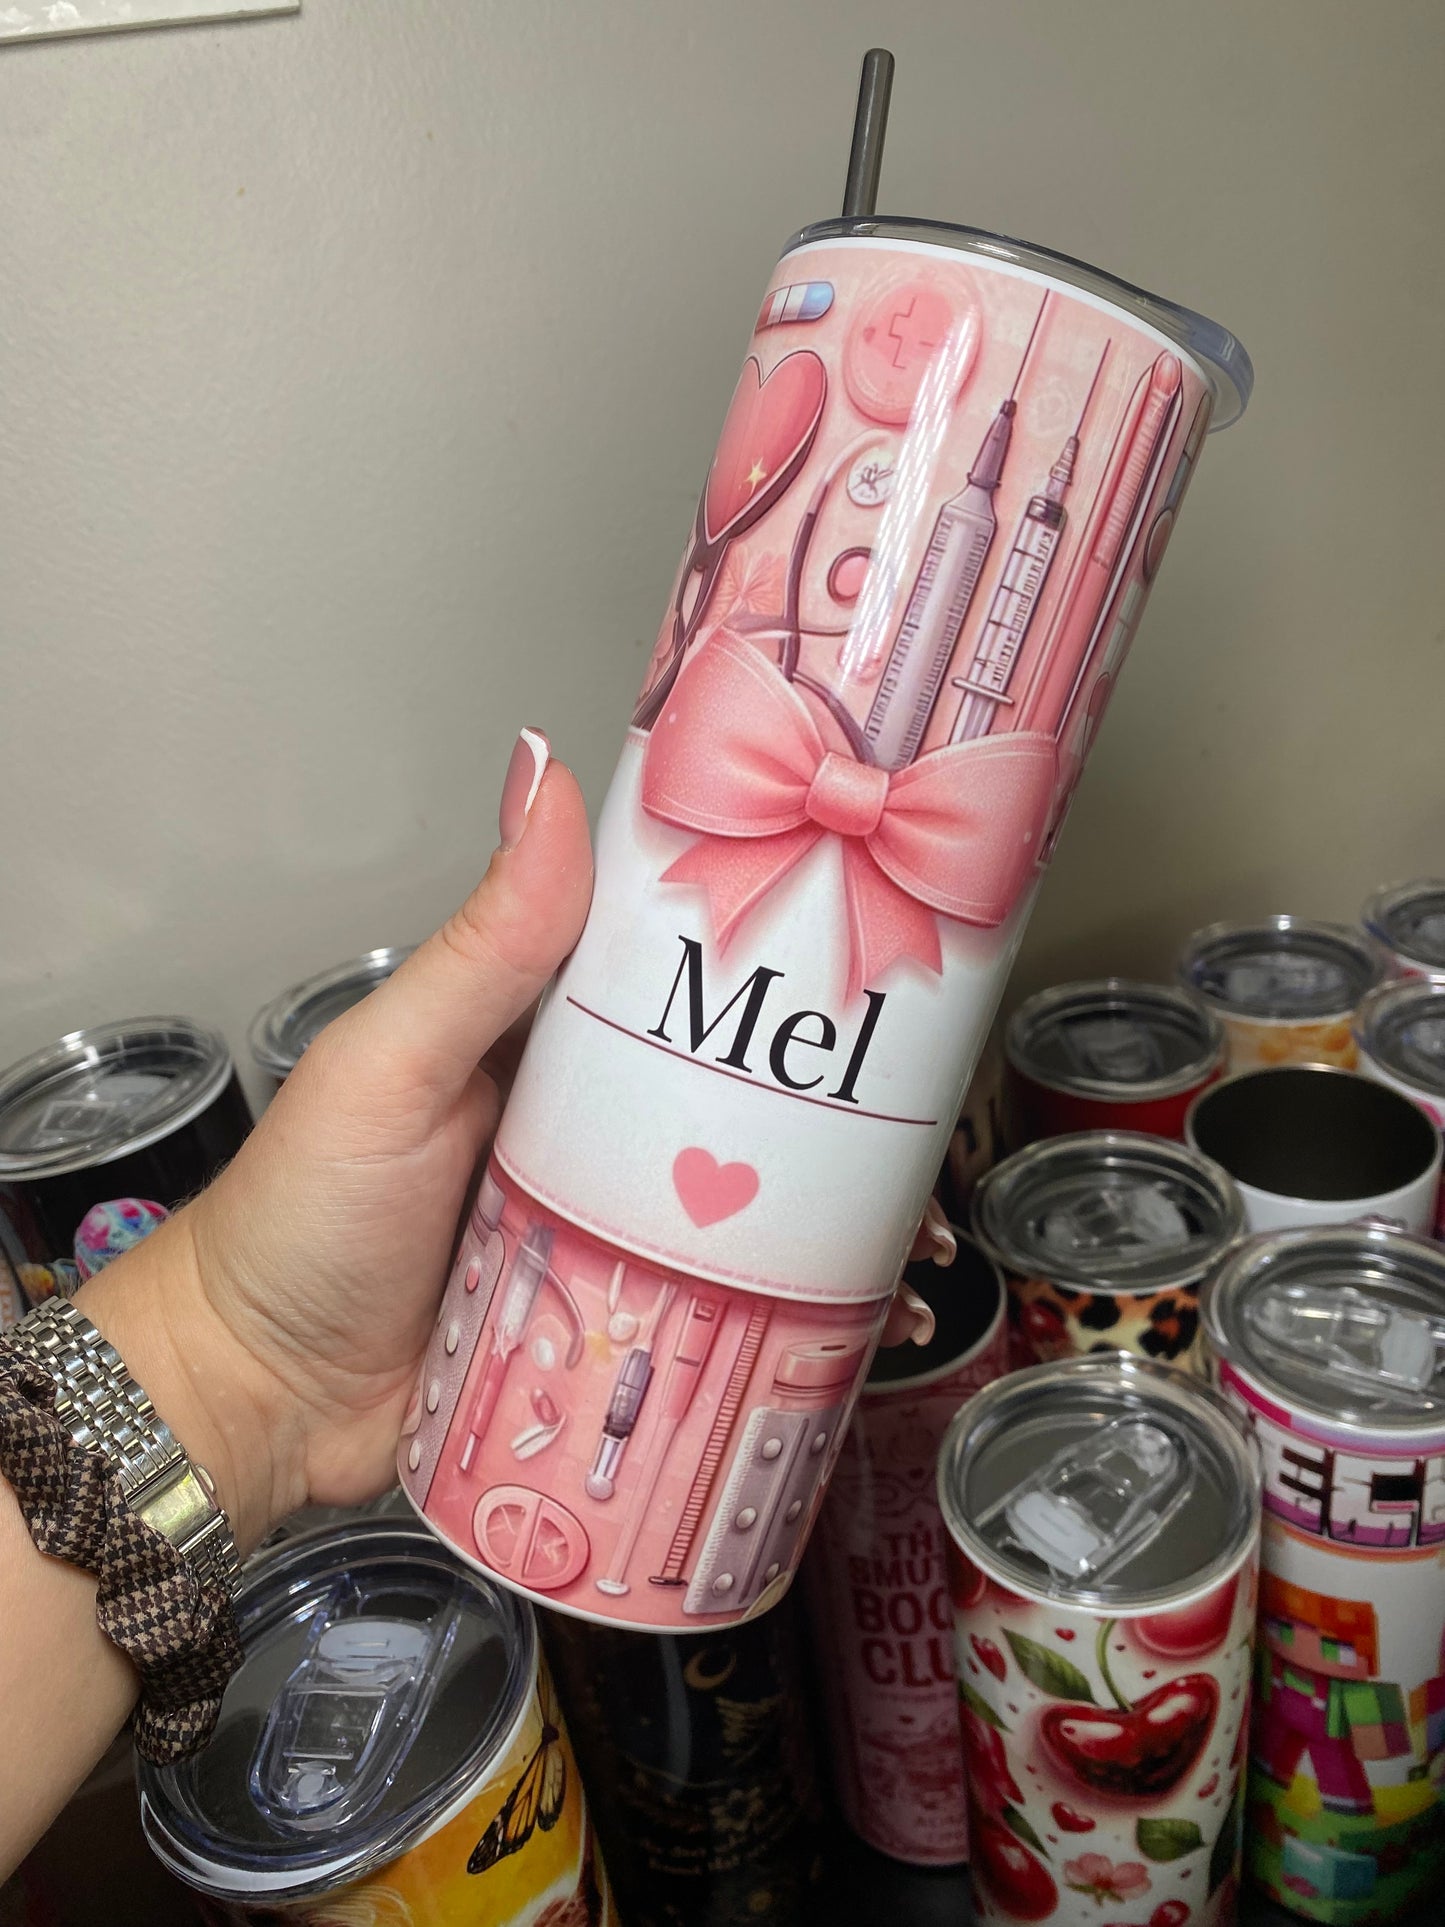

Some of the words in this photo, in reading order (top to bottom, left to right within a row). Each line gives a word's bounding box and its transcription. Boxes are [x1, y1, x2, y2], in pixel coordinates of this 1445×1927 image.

[646, 934, 887, 1104] Mel
[853, 1587, 955, 1635] BOO
[861, 1638, 954, 1688] CLU
